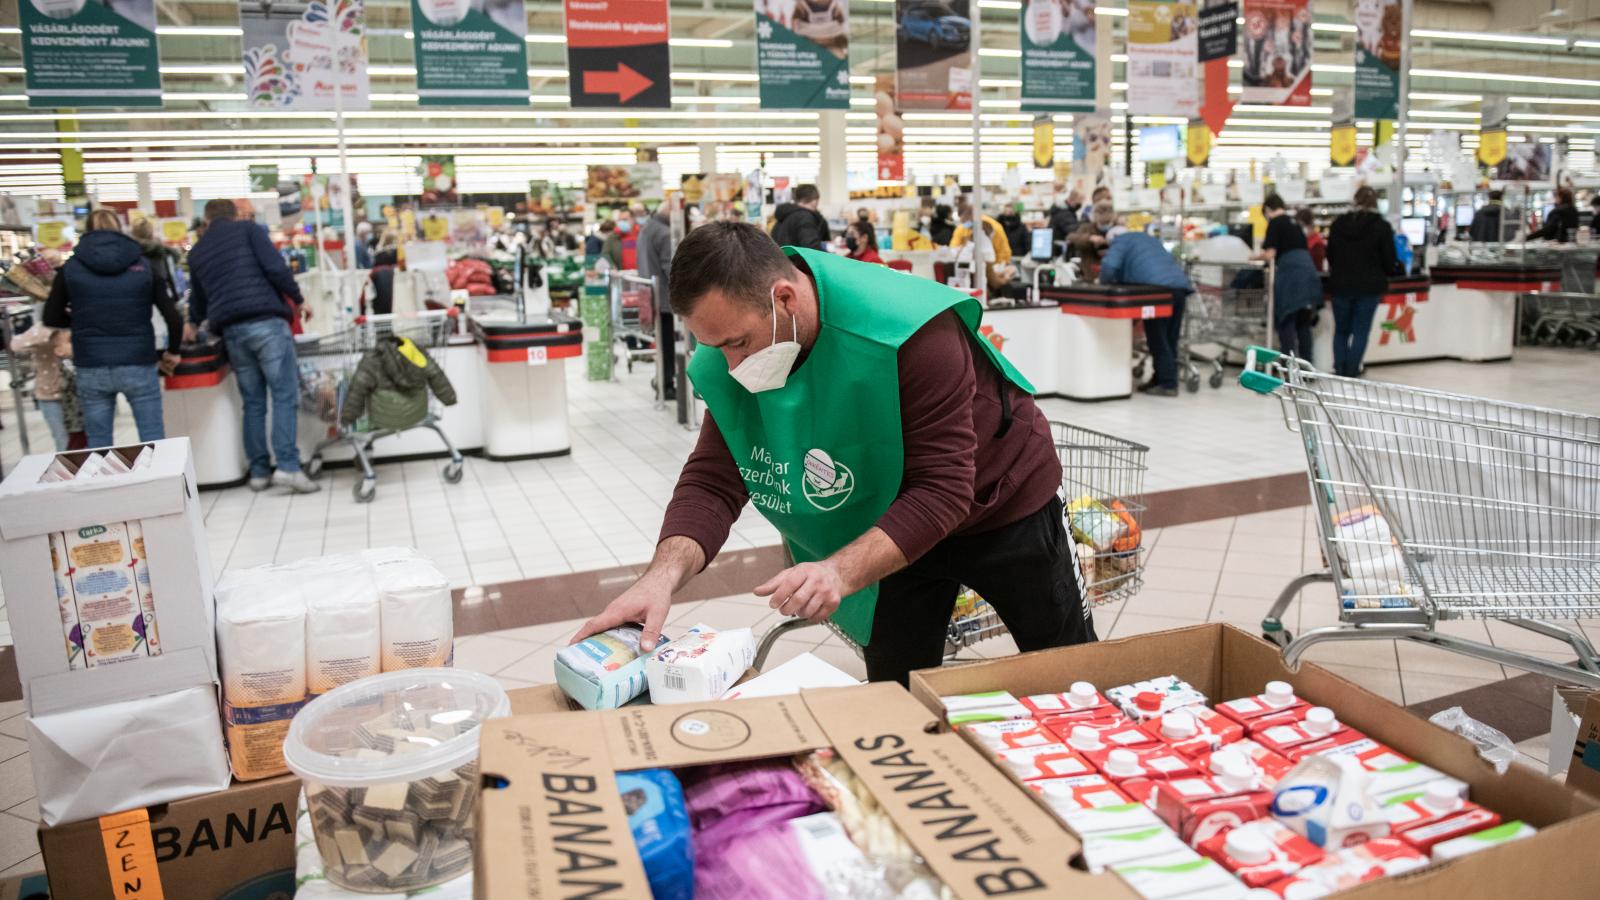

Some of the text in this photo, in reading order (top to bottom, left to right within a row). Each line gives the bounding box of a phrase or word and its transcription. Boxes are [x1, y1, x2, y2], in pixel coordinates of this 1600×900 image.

[29, 23, 119, 35] VÁSÁRLÁSODÉRT
[30, 36, 107, 47] KEDVEZMÉNYT
[531, 350, 545, 361] 10
[750, 445, 790, 475] Maar
[749, 491, 793, 514] esület
[80, 526, 104, 538] Tarka
[853, 734, 1047, 897] BANANAS
[155, 802, 293, 864] BANA
[114, 829, 142, 900] ZEN
